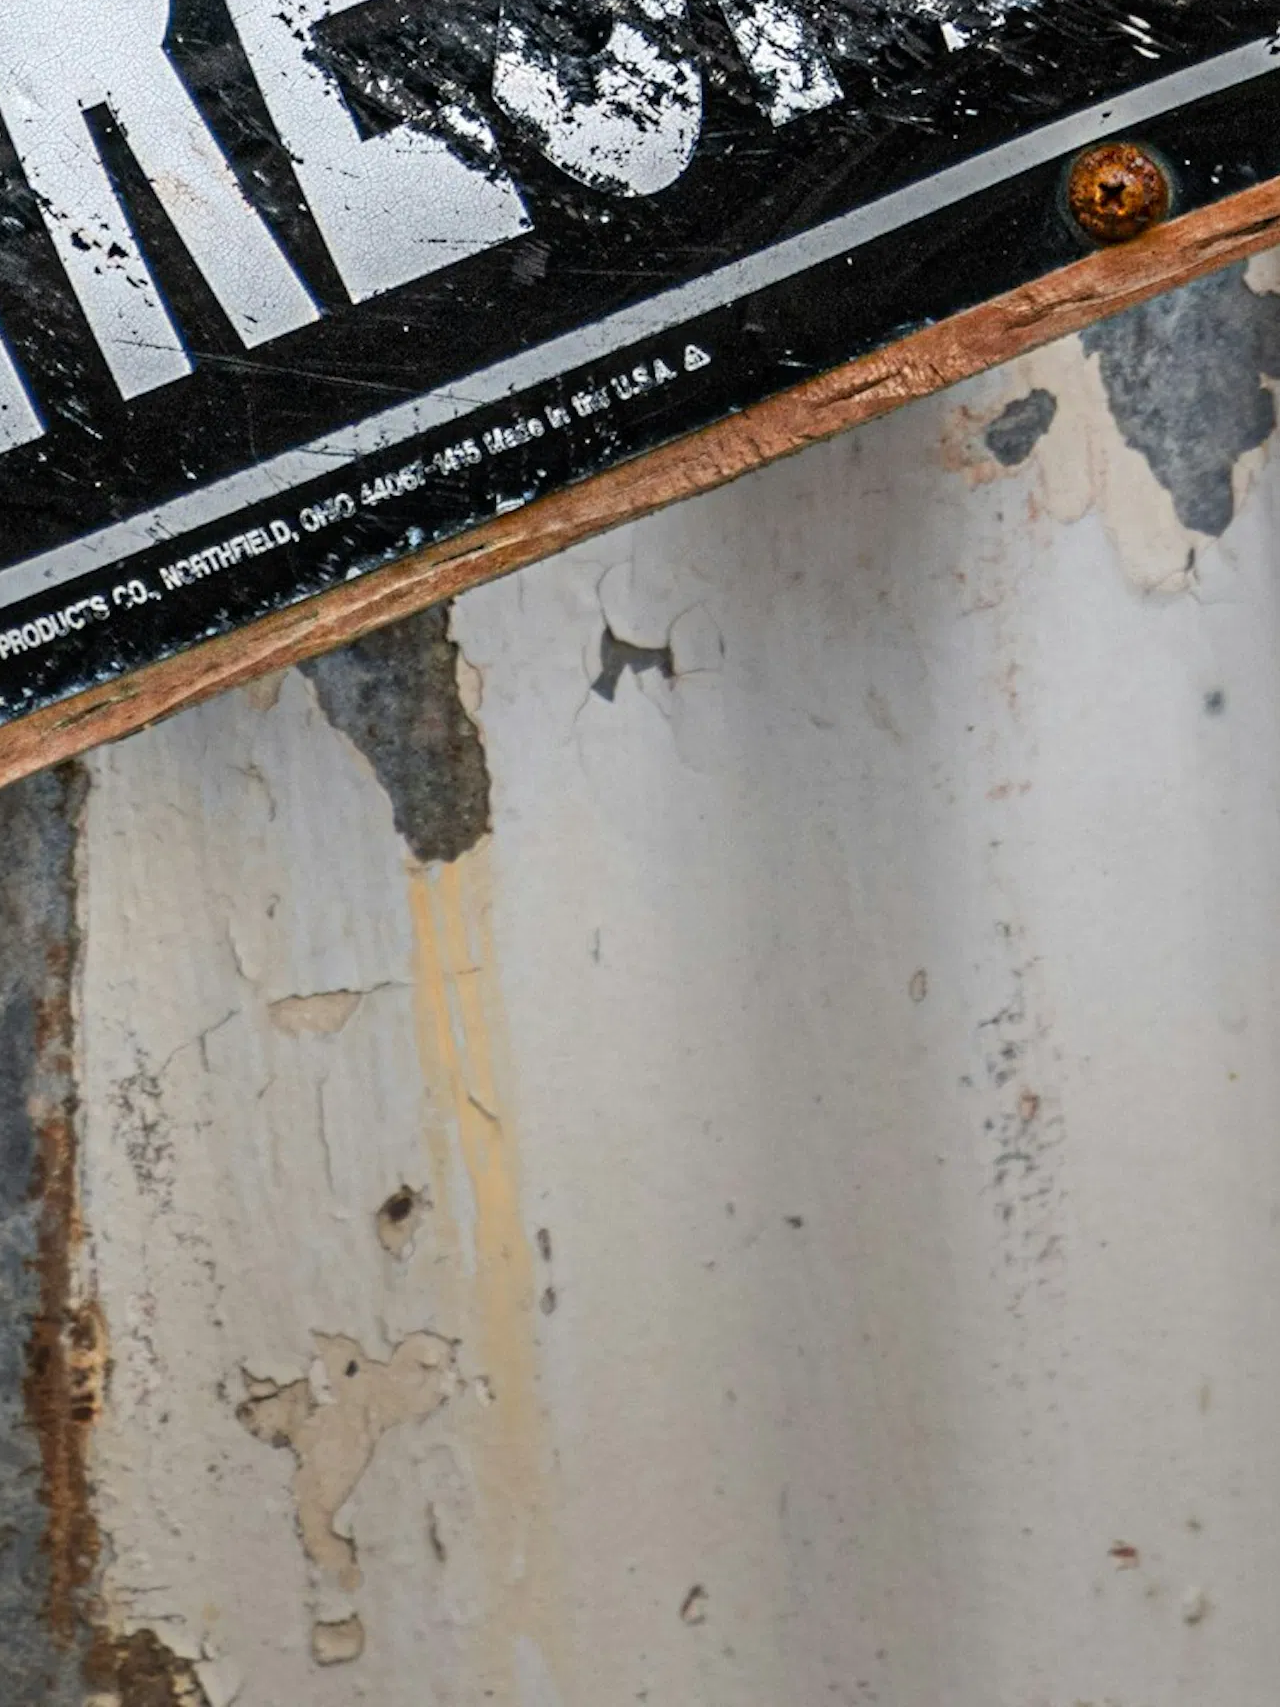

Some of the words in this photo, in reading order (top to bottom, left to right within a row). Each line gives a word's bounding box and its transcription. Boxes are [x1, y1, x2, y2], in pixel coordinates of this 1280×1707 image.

[158, 519, 301, 590] NORTHFIELD,
[300, 492, 357, 533] OHIO
[481, 416, 546, 455] Made
[610, 358, 678, 401] U.S.A.
